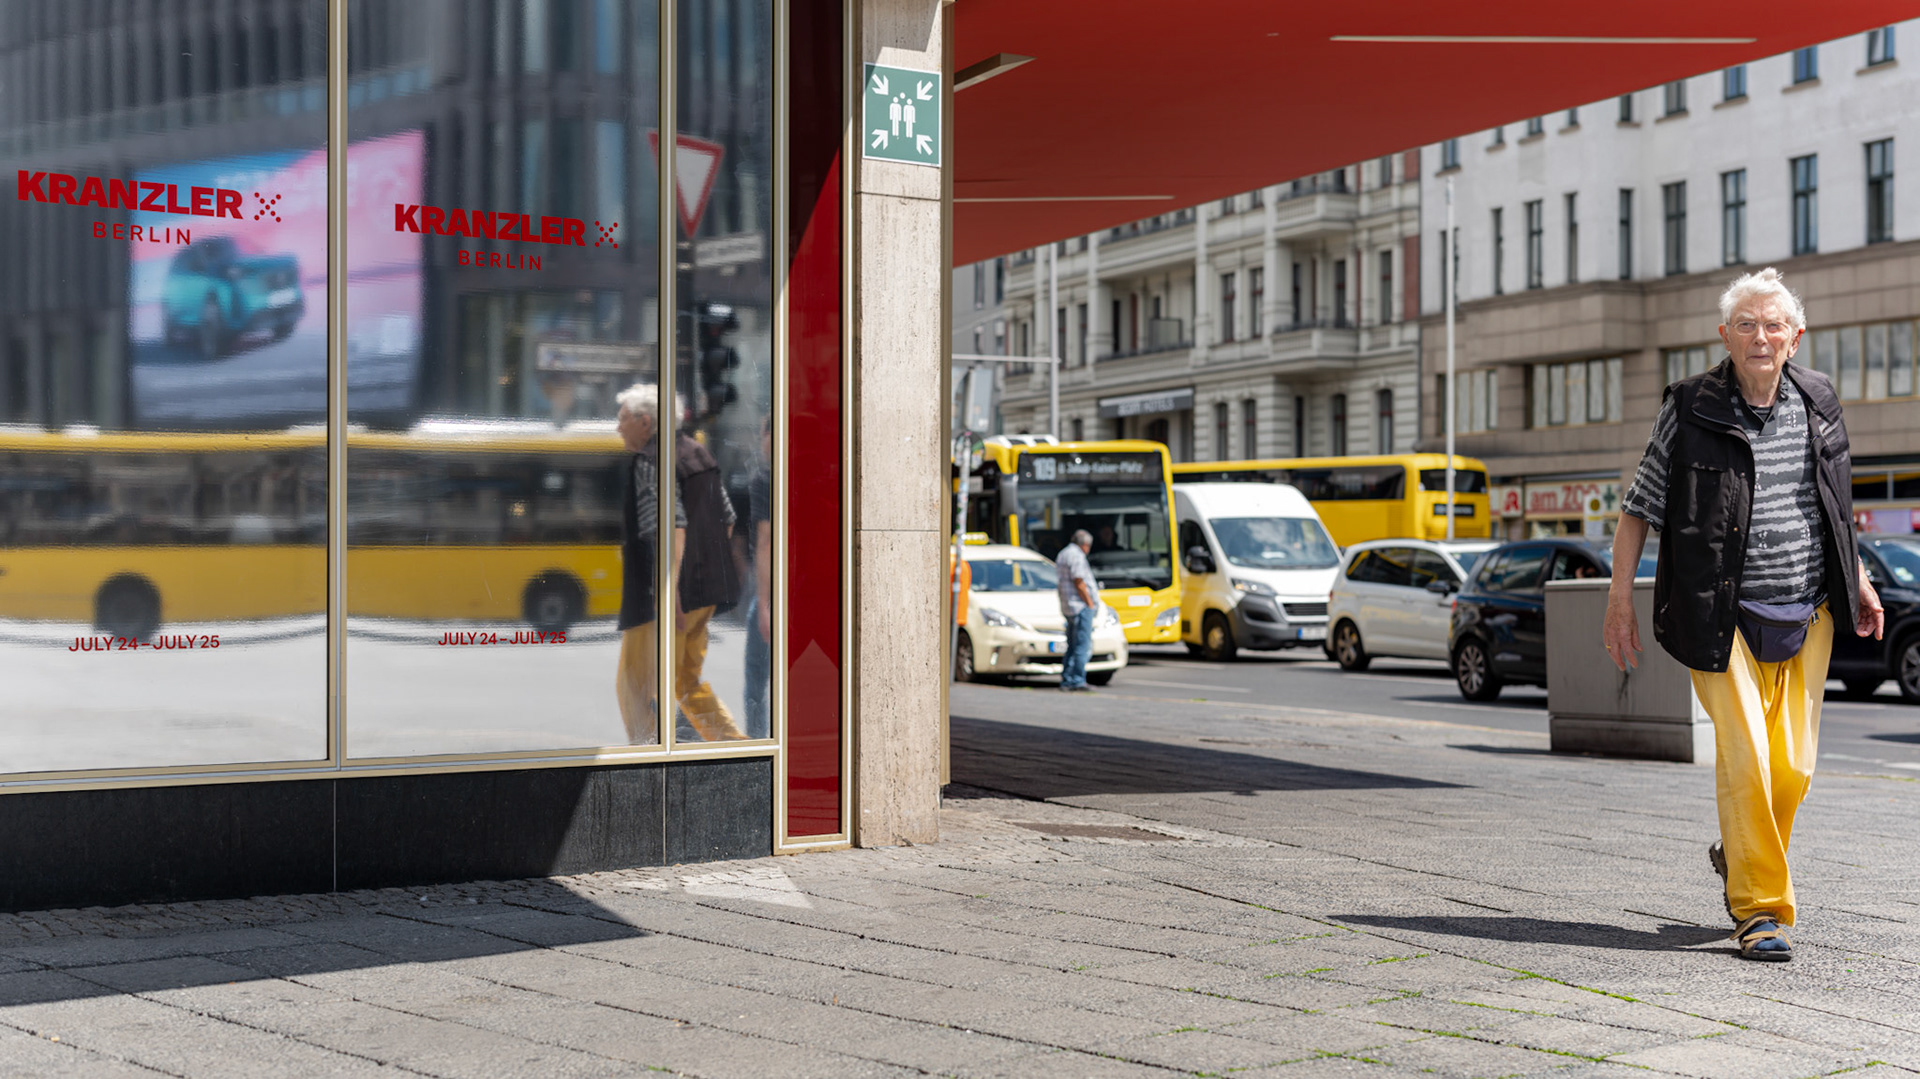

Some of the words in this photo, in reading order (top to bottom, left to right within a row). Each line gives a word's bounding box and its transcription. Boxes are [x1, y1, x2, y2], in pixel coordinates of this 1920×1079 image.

[17, 169, 244, 220] KRANZLER
[92, 221, 191, 246] BERLIN
[394, 203, 586, 247] KRANZLER
[458, 249, 542, 271] BERLIN
[1531, 491, 1558, 511] am
[68, 636, 115, 652] JULY
[117, 636, 139, 651] 24
[152, 634, 197, 650] JULY
[200, 635, 220, 649] 25
[437, 631, 478, 646] JULY
[479, 632, 498, 645] 24
[509, 630, 548, 645] JULY
[549, 631, 567, 644] 25
